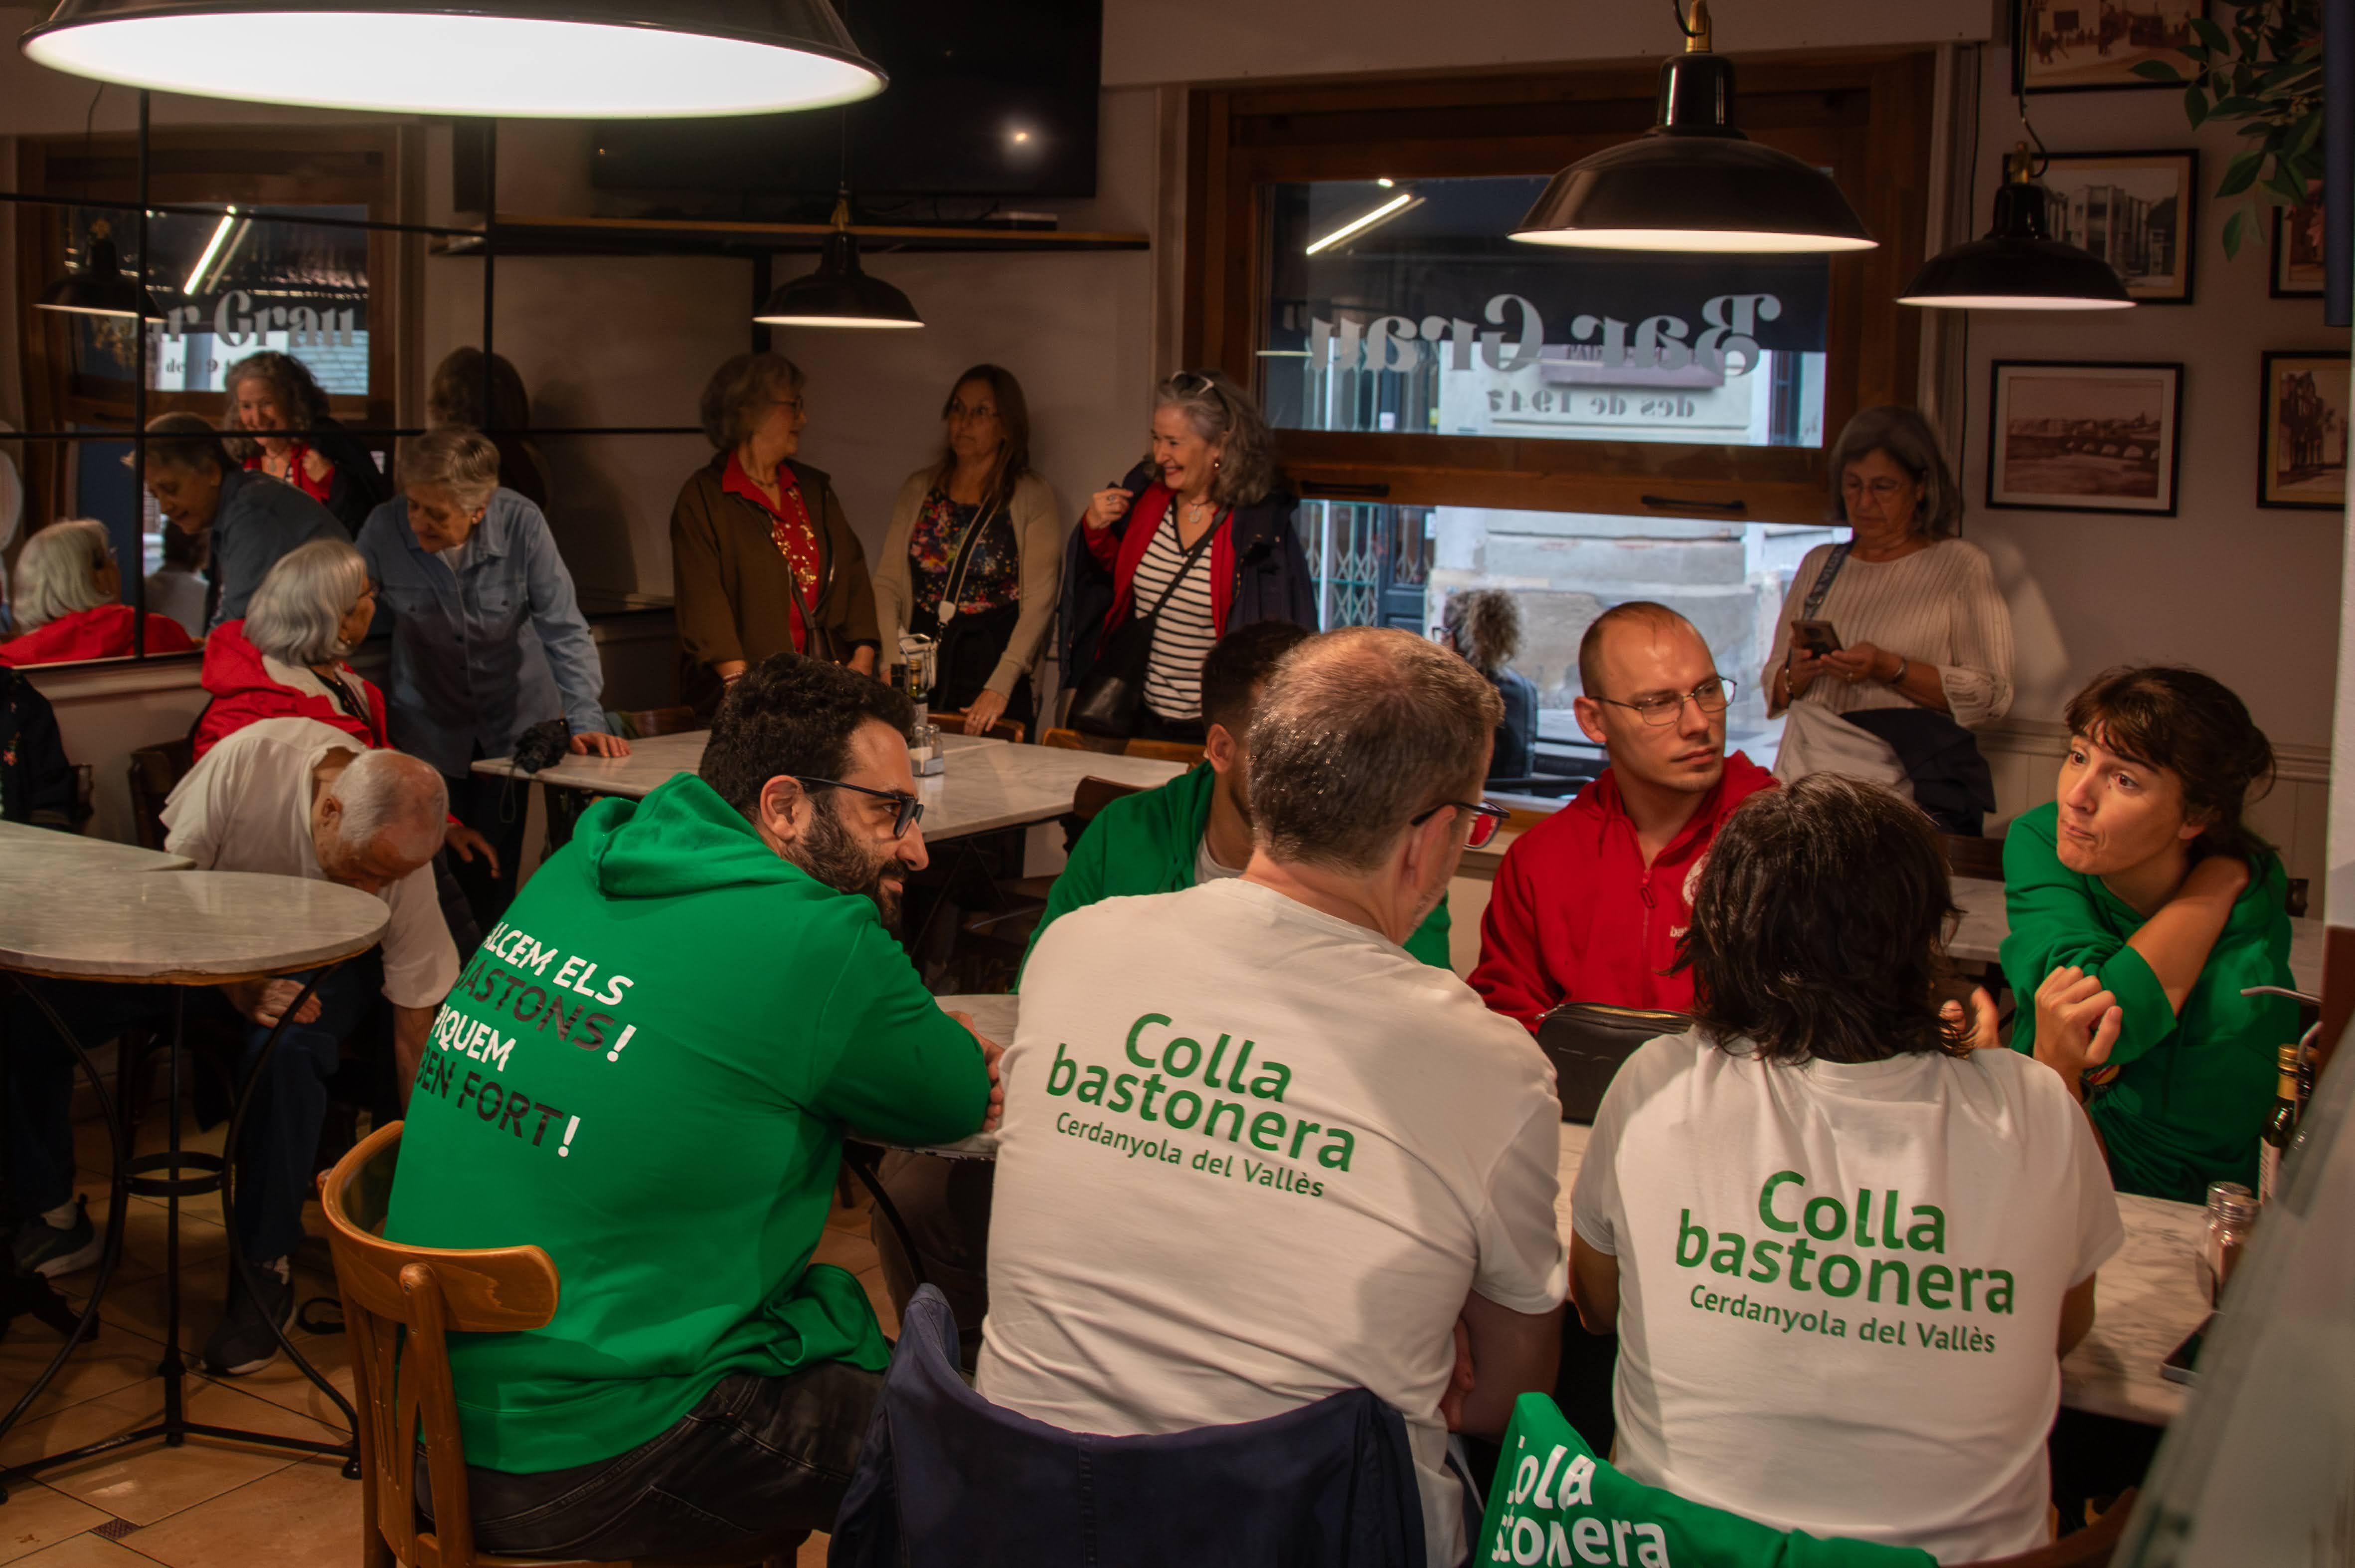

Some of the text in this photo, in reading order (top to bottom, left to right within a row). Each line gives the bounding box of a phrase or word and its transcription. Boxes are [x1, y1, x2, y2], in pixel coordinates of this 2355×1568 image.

[214, 290, 354, 348] Gran
[552, 956, 634, 1005] ELS
[1125, 1013, 1292, 1103] Colla
[1046, 1043, 1355, 1173] bastonera
[1056, 1112, 1325, 1198] Cerdanyola del Vallès
[1758, 1170, 1945, 1254] Colla
[1675, 1209, 2015, 1315] bastonera
[1690, 1284, 1997, 1353] Cerdanyola del Vallès
